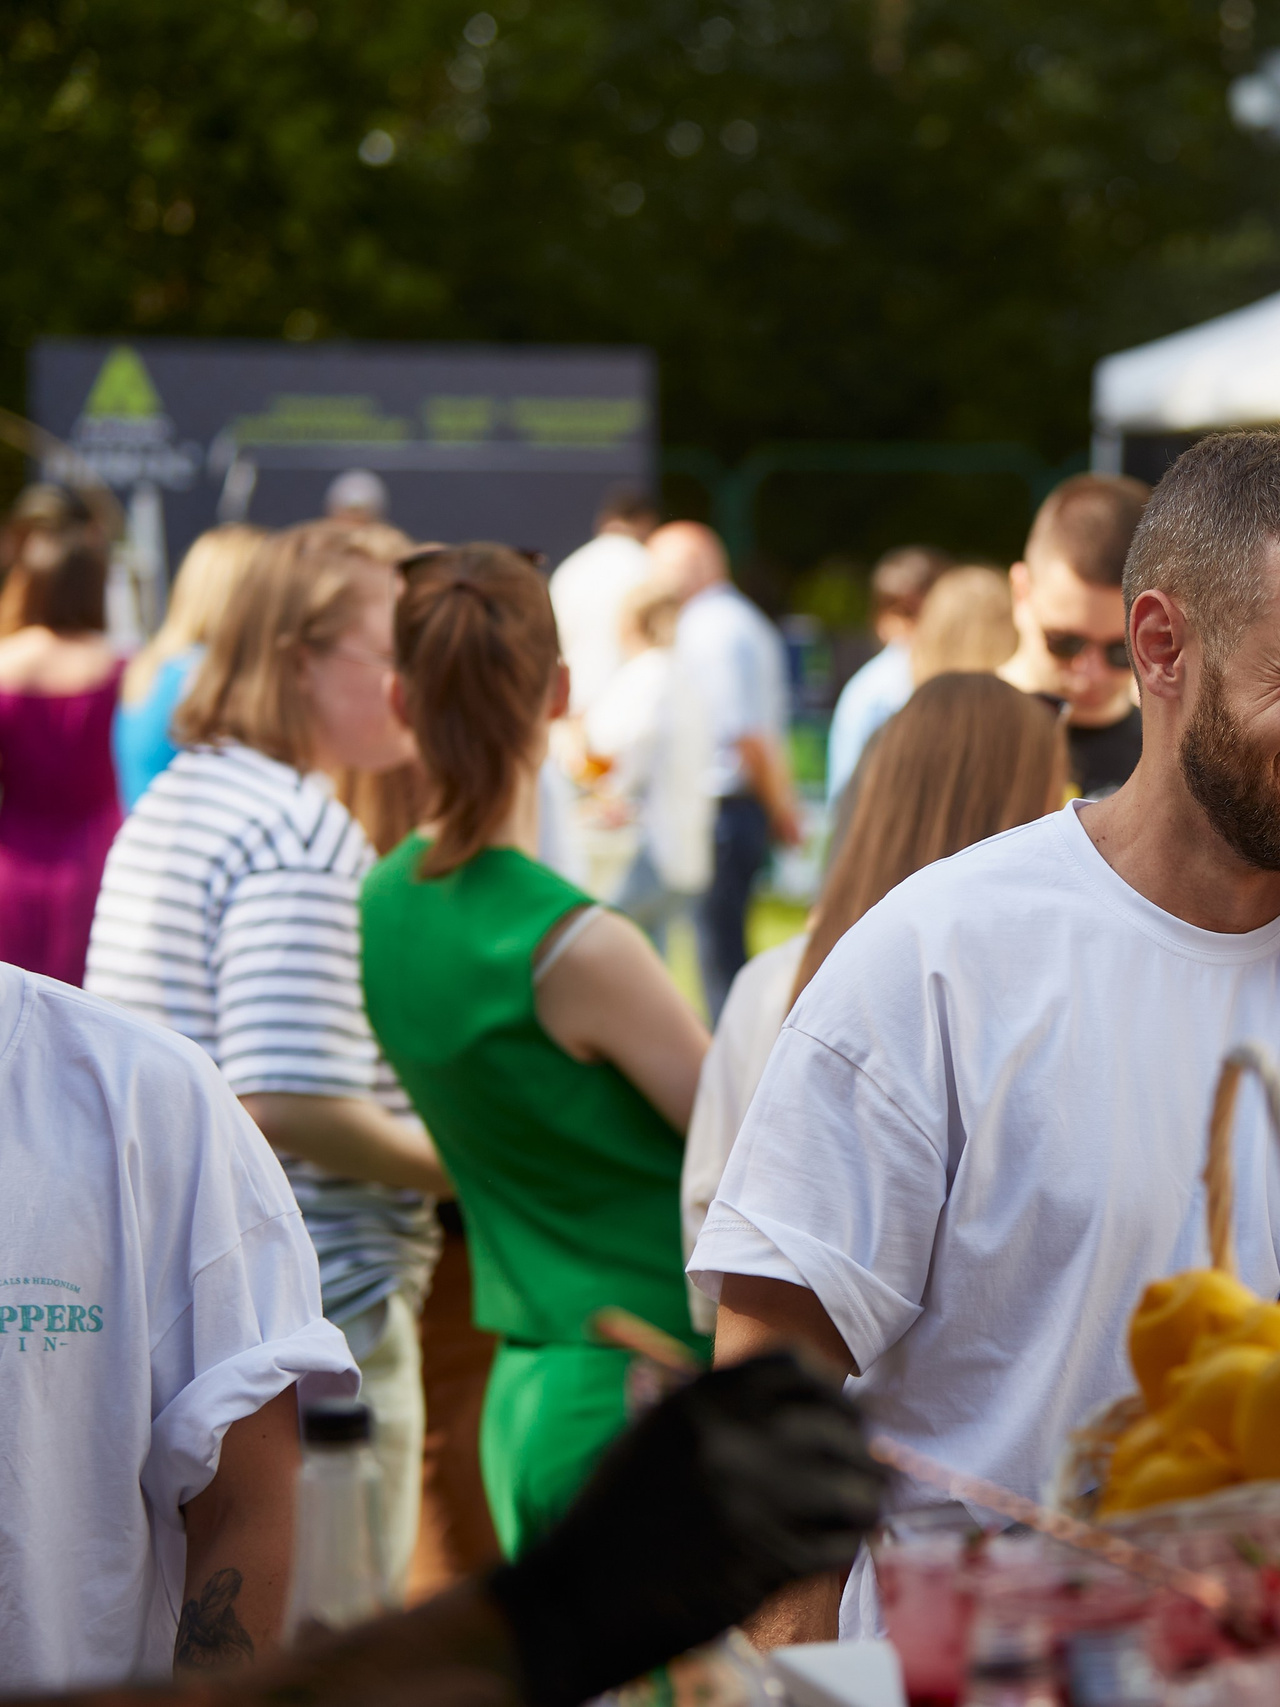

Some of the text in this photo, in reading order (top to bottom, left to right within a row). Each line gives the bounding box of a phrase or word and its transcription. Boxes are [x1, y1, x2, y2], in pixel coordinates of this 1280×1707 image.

[23, 1277, 31, 1285] &
[32, 1277, 81, 1294] HEDONISM
[0, 1304, 104, 1334] PPERS
